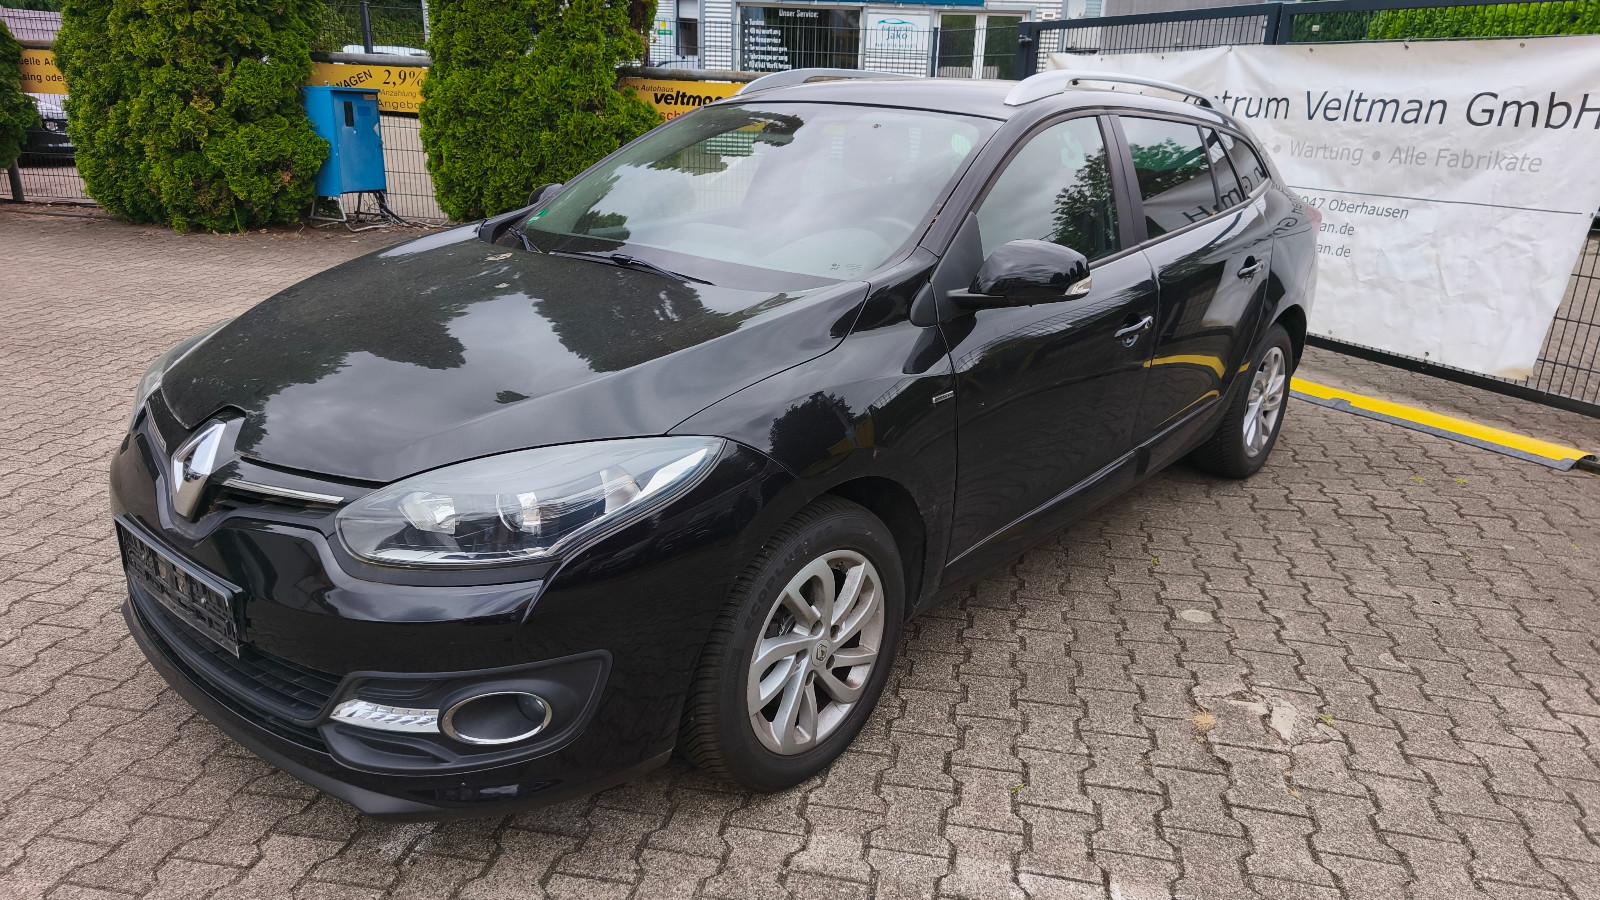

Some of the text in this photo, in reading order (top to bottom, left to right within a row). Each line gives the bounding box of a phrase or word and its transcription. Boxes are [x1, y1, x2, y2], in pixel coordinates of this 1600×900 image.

[779, 9, 795, 18] Unser
[640, 85, 674, 93] Autohaus
[1306, 90, 1448, 125] Veltman
[1466, 91, 1600, 130] GmbH
[1290, 139, 1543, 173] Wartung Alle Fabrikate
[1328, 199, 1409, 219] Oberhausen
